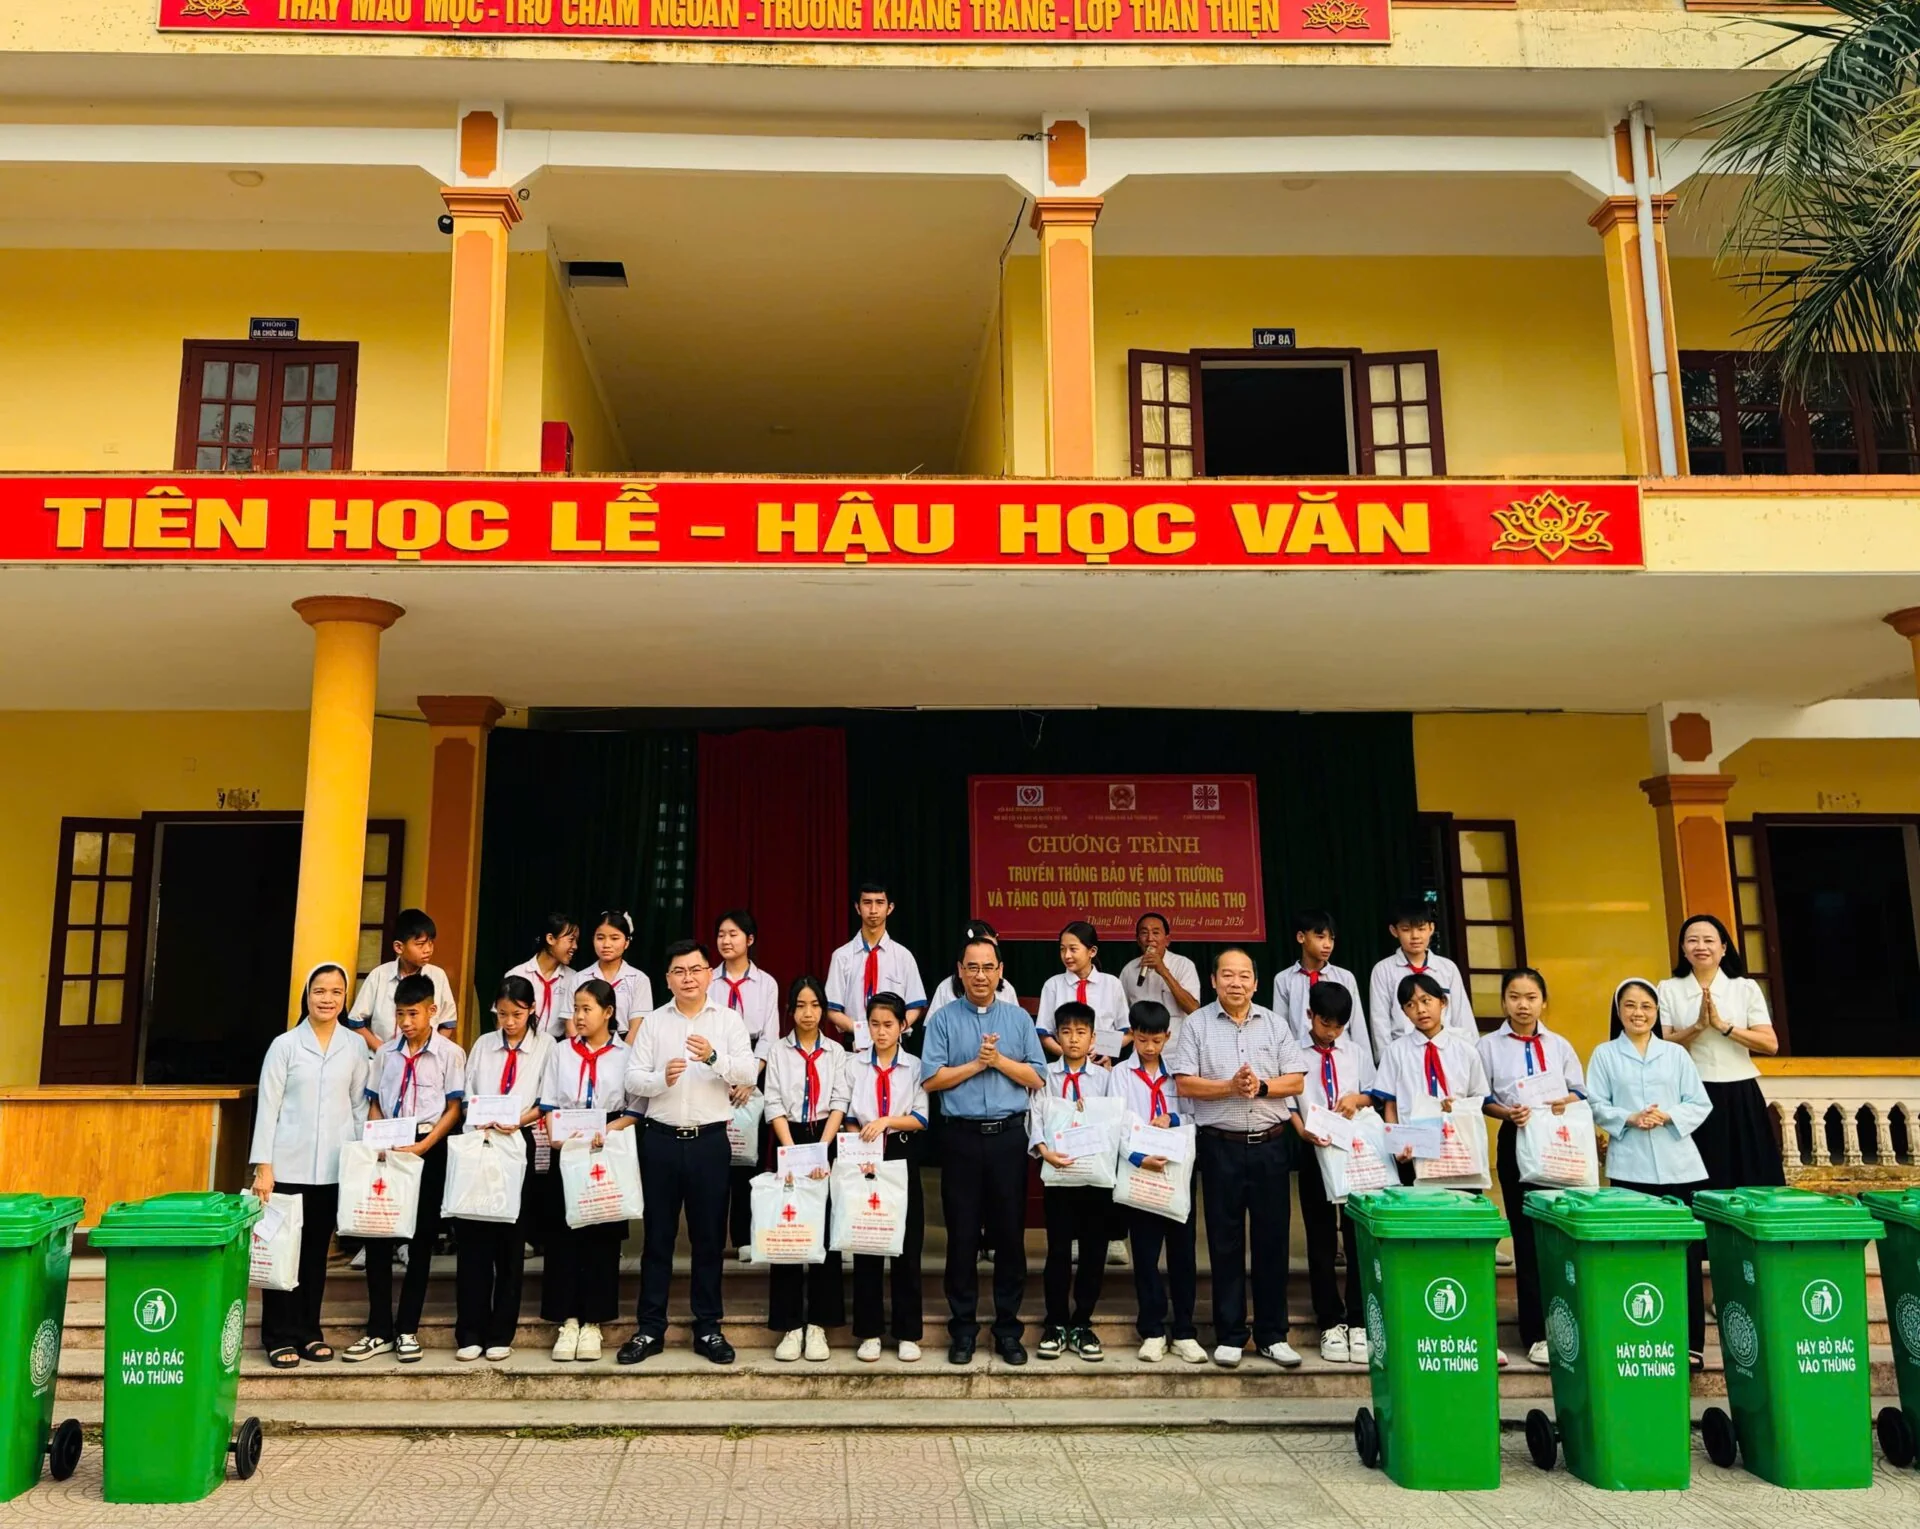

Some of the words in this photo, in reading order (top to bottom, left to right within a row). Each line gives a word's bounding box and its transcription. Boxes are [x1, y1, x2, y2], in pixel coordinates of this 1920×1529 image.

[873, 0, 961, 31] KHANG
[970, 0, 1055, 32] TRANG
[1258, 331, 1276, 345] LỚP
[1278, 334, 1291, 345] 8A
[44, 485, 268, 549] TIÊN
[306, 498, 510, 560] HỌC
[550, 484, 661, 552] LỄ
[691, 524, 725, 537] -
[757, 491, 955, 563] HẬU
[1000, 502, 1197, 563] HỌC
[1230, 491, 1431, 554] VĂN
[1028, 834, 1121, 854] CHƯƠNG
[1127, 832, 1200, 854] TRÌNH
[1058, 863, 1098, 882] THÔNG
[1101, 860, 1126, 882] BẢO
[1129, 863, 1145, 886] VỆ
[1147, 863, 1172, 882] MÔI
[1175, 862, 1224, 883] TRƯỜNG
[987, 887, 1004, 907] VÀ
[1006, 887, 1039, 911] TẶNG
[1042, 887, 1067, 909] QUÀ
[1069, 891, 1089, 911] TẠI
[1092, 887, 1141, 908] TRƯỜNG
[1144, 892, 1176, 908] THCS
[1179, 888, 1220, 908] THĂNG
[1222, 892, 1247, 912] THỌ
[1224, 916, 1245, 926] 2026
[1440, 1335, 1455, 1353] BỎ
[1457, 1336, 1478, 1353] RÁC
[1638, 1340, 1653, 1359] BỎ
[1655, 1340, 1675, 1358] RÁC
[1818, 1336, 1833, 1355] BỎ
[1835, 1336, 1855, 1354] RÁC
[145, 1347, 161, 1366] BỎ
[163, 1348, 185, 1366] RÁC
[1418, 1354, 1441, 1372] VÀO
[1442, 1355, 1479, 1372] THÙNG
[1798, 1356, 1820, 1374] VÀO
[1821, 1355, 1856, 1373] THÙNG
[122, 1366, 144, 1385] VÀO
[146, 1367, 184, 1385] THÙNG
[1617, 1359, 1640, 1377] VÀO
[1641, 1359, 1676, 1377] THÙNG
